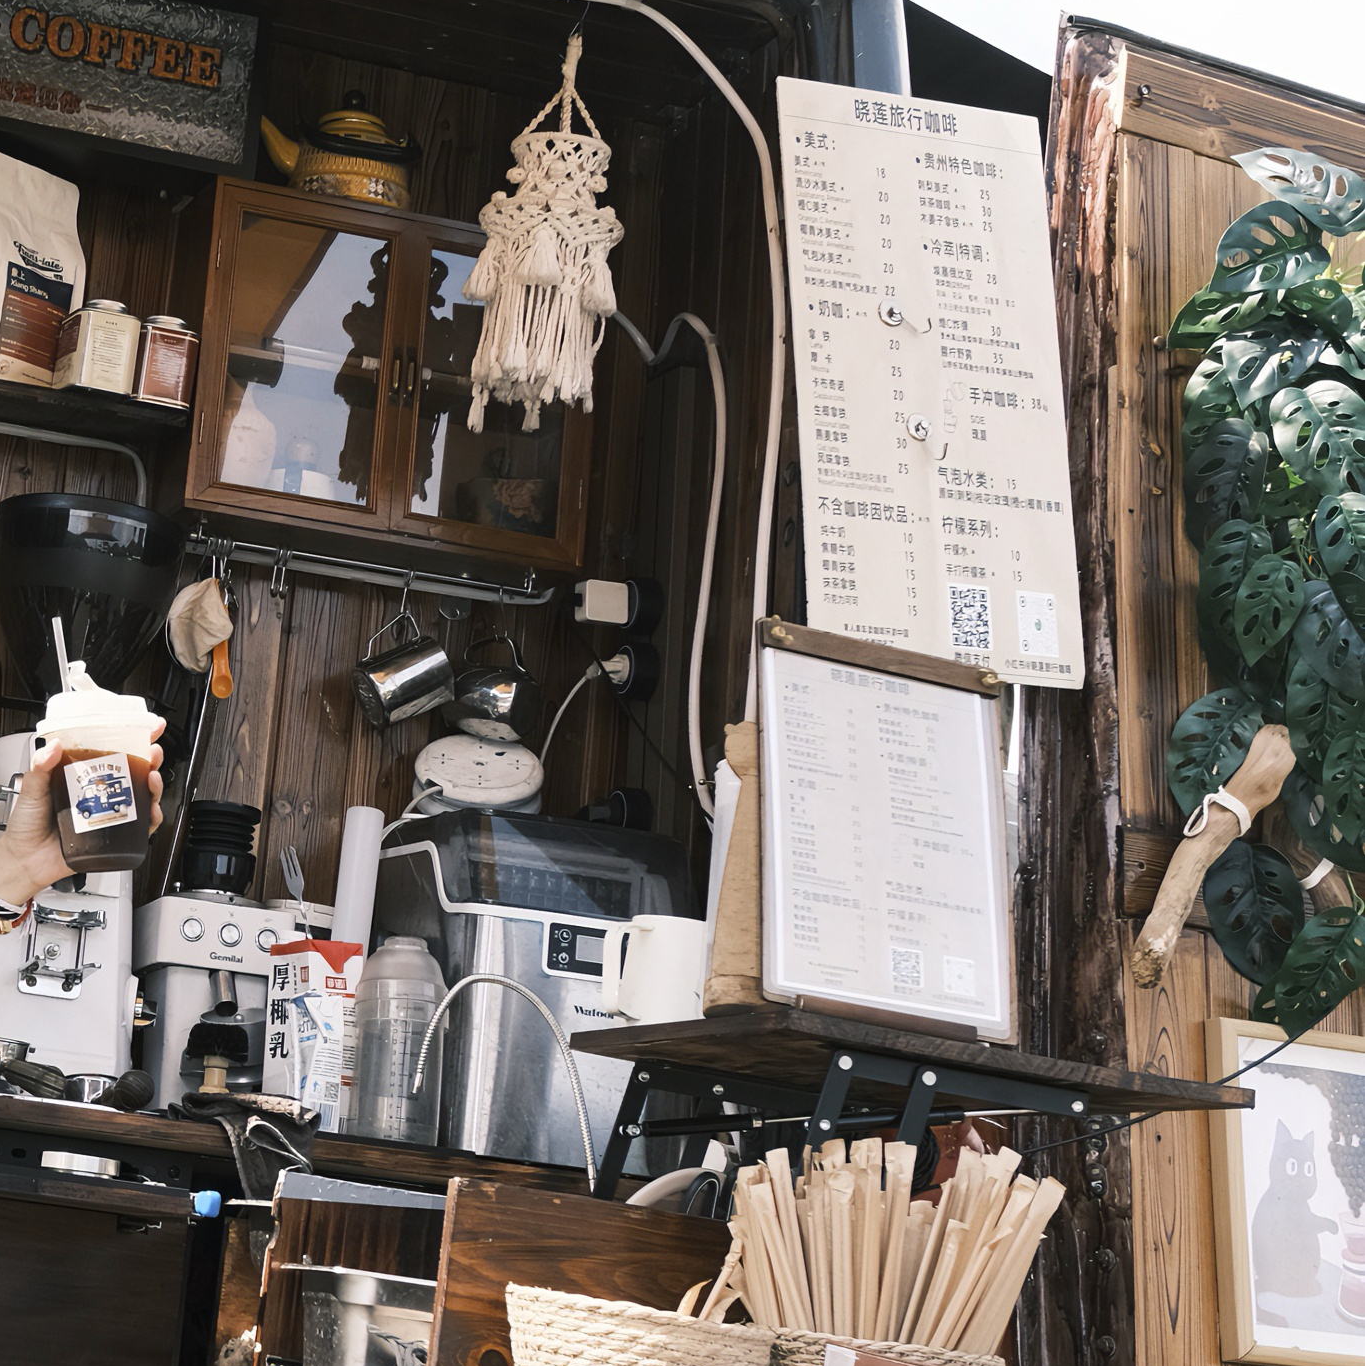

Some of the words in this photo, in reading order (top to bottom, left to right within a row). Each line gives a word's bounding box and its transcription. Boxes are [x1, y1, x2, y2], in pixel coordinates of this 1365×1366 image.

[10, 7, 225, 90] COFFEE
[854, 99, 958, 136] 晓莲旅行咖啡
[876, 167, 886, 179] 18
[878, 191, 889, 203] 20
[979, 189, 990, 201] 25
[982, 206, 992, 218] 30
[880, 214, 891, 225] 20
[983, 221, 993, 233] 25
[881, 238, 892, 249] 20
[883, 263, 894, 274] 20
[987, 274, 997, 285] 28
[885, 285, 896, 297] 22
[991, 326, 1002, 337] 30
[889, 339, 900, 351] 20
[993, 352, 1004, 365] 35
[891, 366, 902, 377] 25
[893, 390, 904, 401] 20
[895, 411, 906, 423] 25
[897, 437, 908, 449] 30
[898, 463, 909, 475] 25
[1006, 478, 1017, 490] 15
[903, 532, 914, 544] 10
[904, 551, 915, 563] 15
[1011, 550, 1021, 561] 10
[905, 569, 916, 581] 15
[1012, 570, 1023, 582] 15
[906, 587, 917, 599] 15
[907, 605, 918, 617] 15
[269, 963, 291, 1059] 厚椰乳
